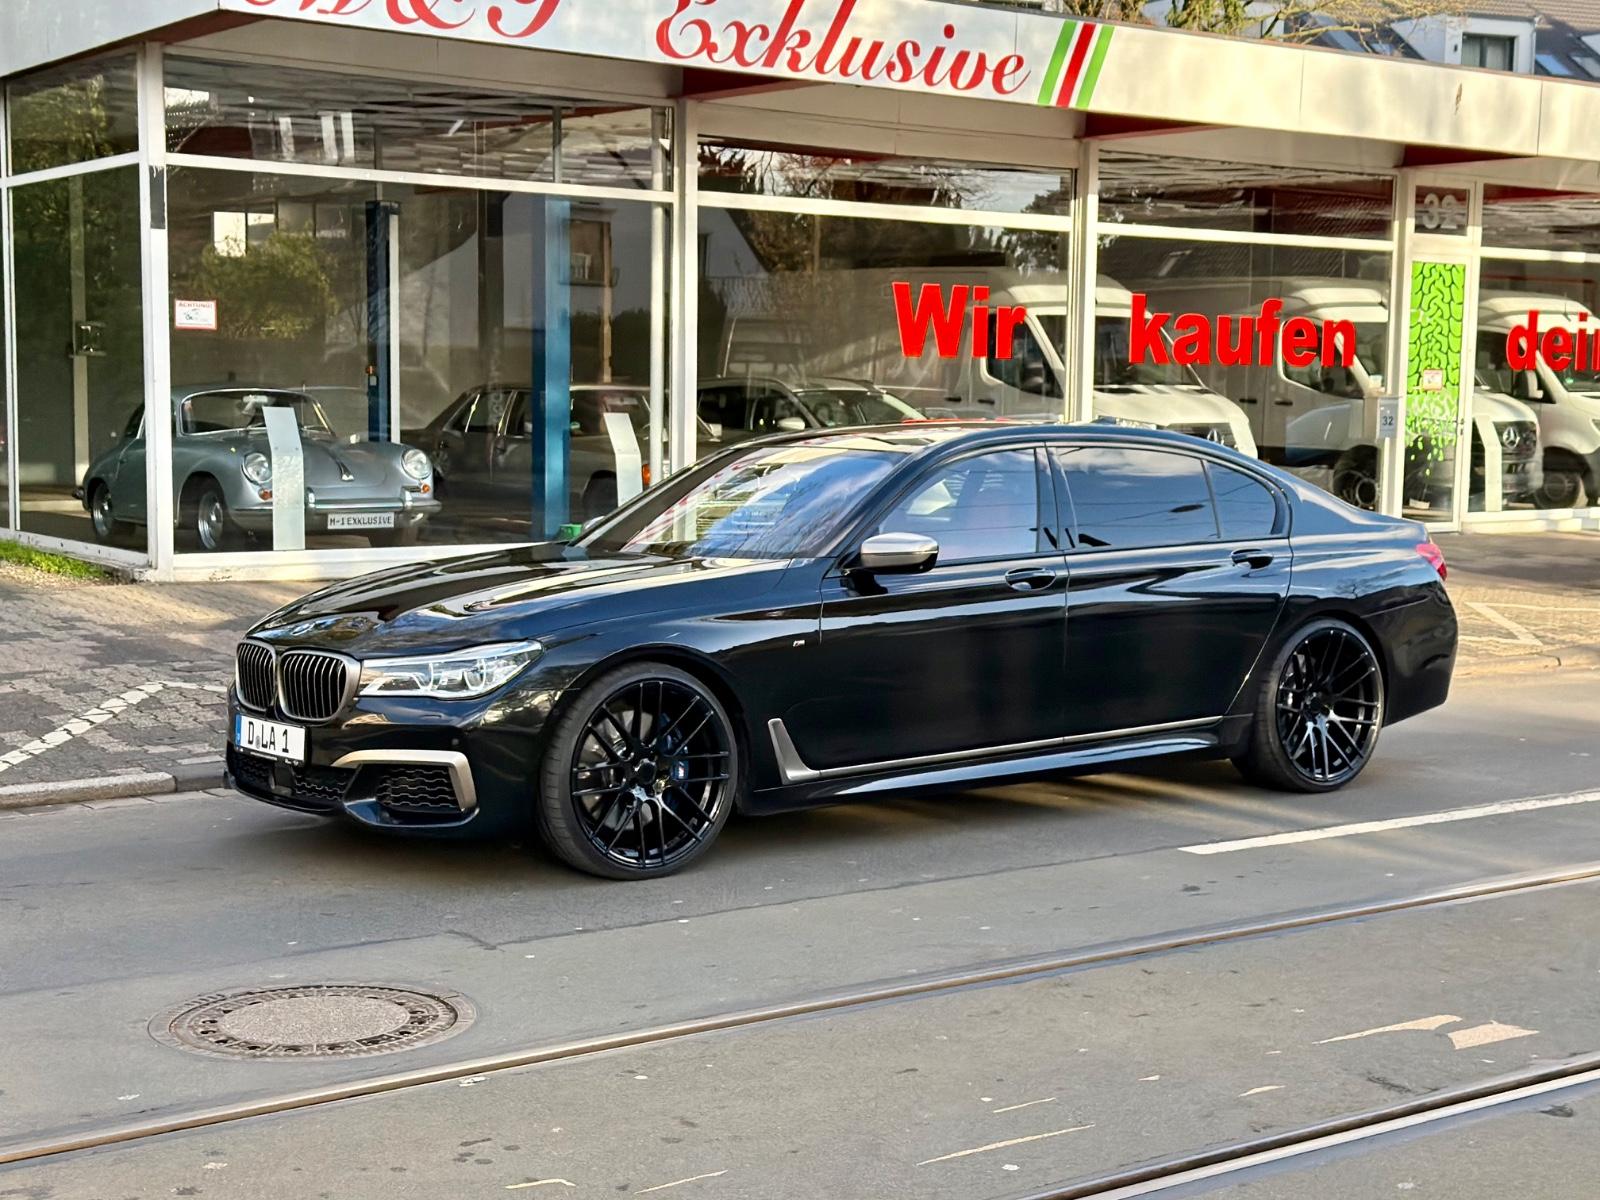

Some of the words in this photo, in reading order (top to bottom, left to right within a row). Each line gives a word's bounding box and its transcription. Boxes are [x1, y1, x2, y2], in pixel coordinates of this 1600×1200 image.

[655, 0, 1031, 95] Exklusive
[1422, 192, 1458, 230] 32
[892, 281, 1027, 360] Wir
[1129, 292, 1357, 368] kaufen
[1506, 309, 1600, 372] dei
[1382, 415, 1394, 426] 32
[282, 728, 288, 753] 1
